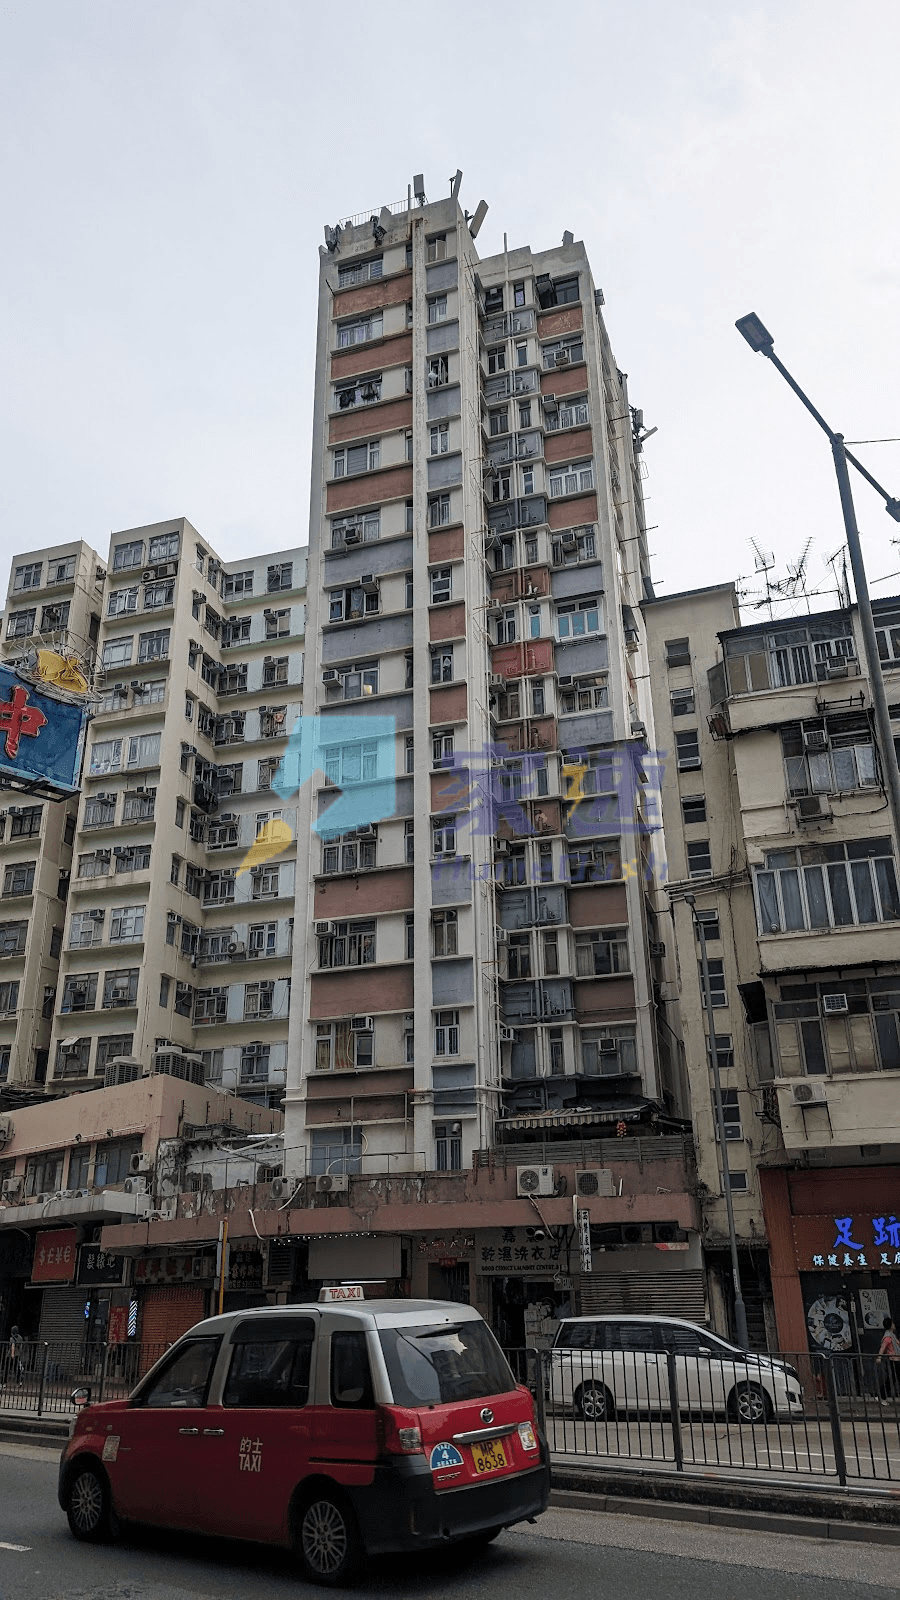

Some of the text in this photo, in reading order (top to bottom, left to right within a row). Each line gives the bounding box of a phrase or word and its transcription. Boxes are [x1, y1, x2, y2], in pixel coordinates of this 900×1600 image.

[481, 1245, 560, 1262] 乾濕洗衣店
[812, 1252, 868, 1267] 保健養生
[329, 1287, 361, 1299] TAXI
[239, 1436, 264, 1454] 的士
[436, 1443, 451, 1452] TAXI
[436, 1458, 457, 1467] SEATS
[441, 1450, 450, 1460] 4
[477, 1453, 505, 1471] 8638
[238, 1453, 262, 1473] TAXI
